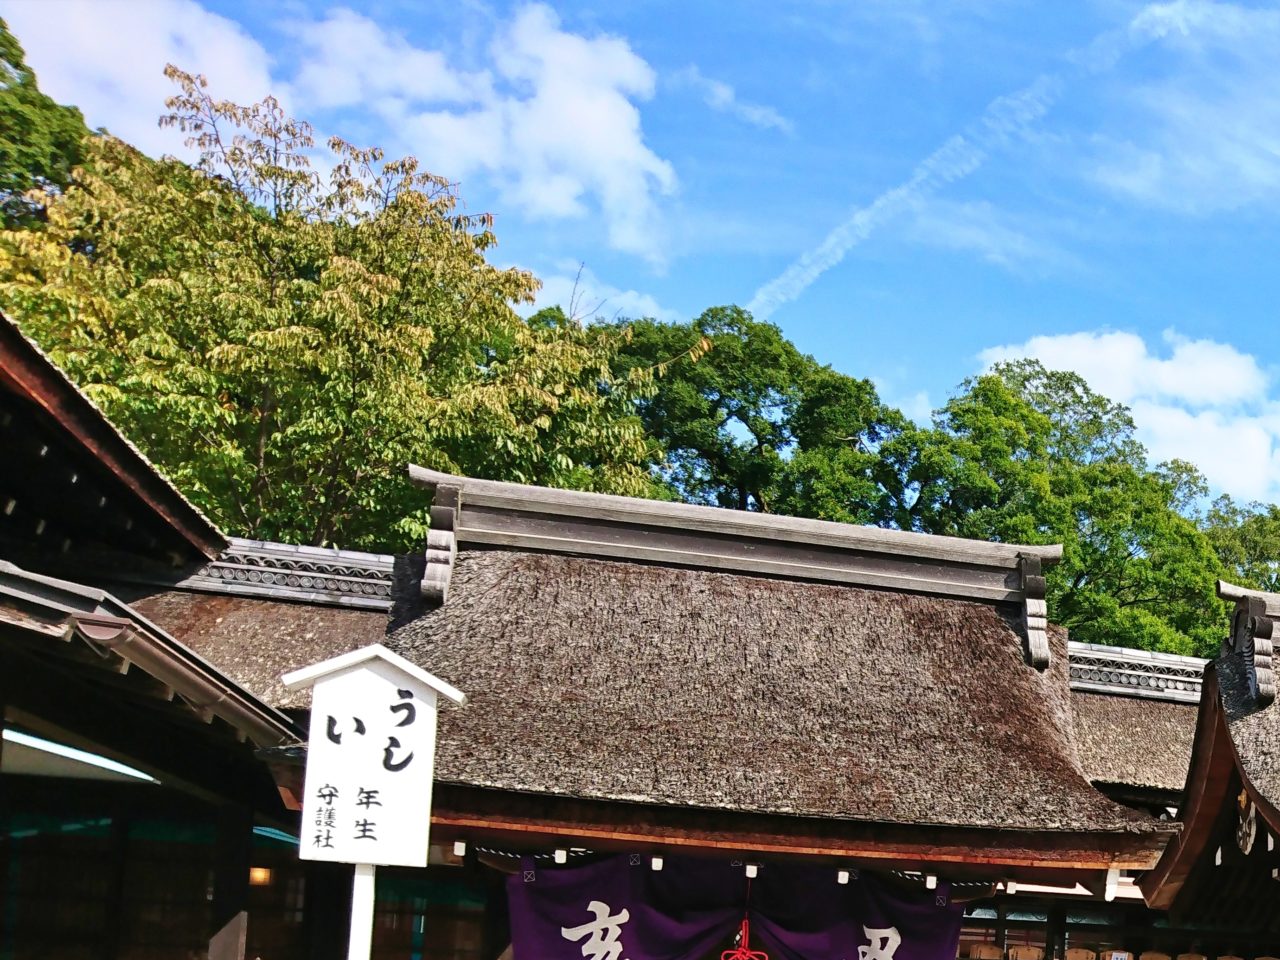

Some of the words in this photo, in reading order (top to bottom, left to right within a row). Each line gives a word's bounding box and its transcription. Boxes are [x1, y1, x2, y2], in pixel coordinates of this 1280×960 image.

[326, 715, 366, 745] い
[382, 688, 417, 772] うし
[312, 783, 339, 849] 守護社
[353, 787, 383, 841] 年生
